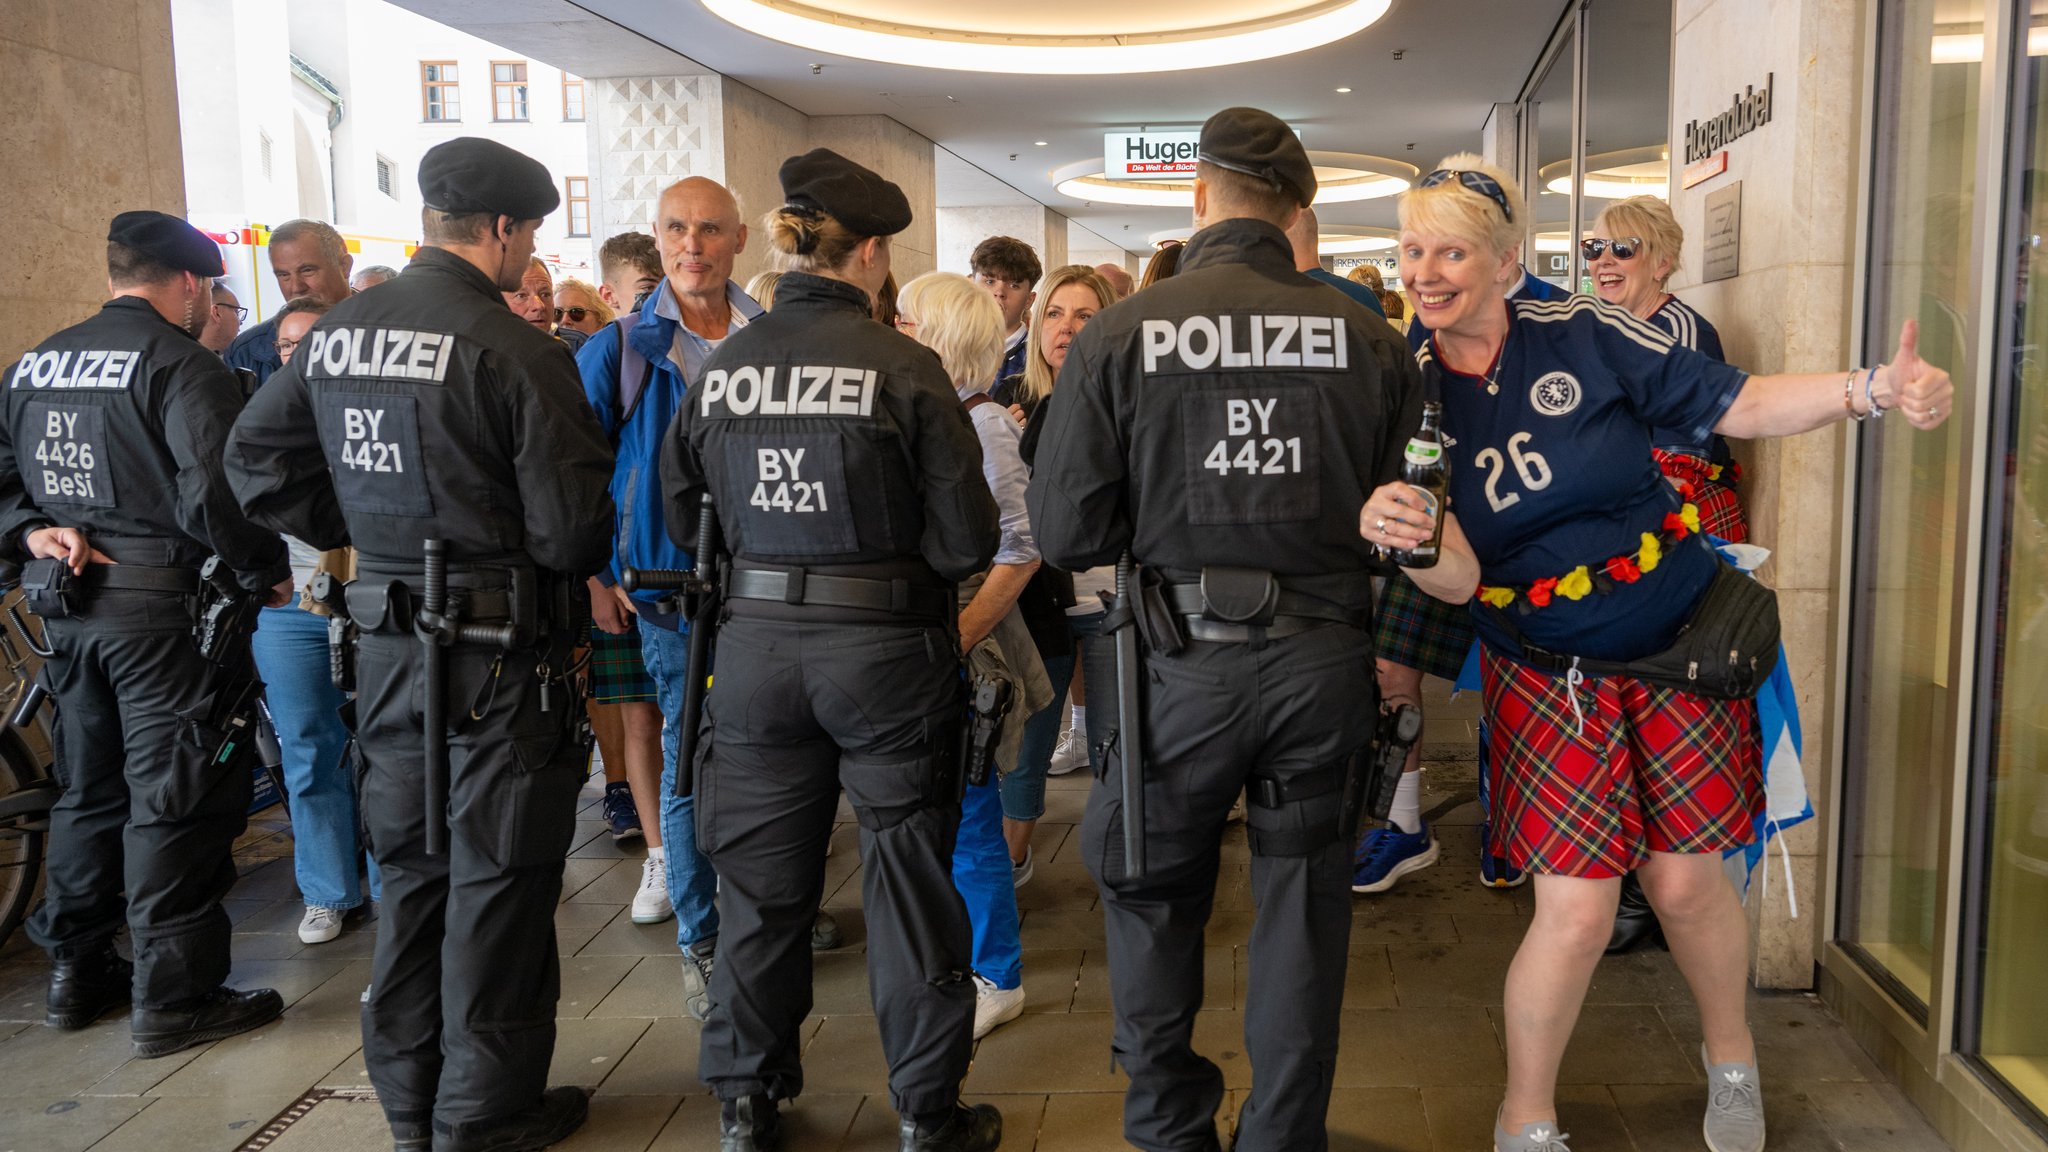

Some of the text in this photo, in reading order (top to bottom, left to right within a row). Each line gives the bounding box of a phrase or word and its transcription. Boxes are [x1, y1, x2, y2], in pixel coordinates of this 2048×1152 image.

[1684, 72, 1774, 165] Hugendubel
[308, 329, 453, 381] POLIZEI
[1143, 315, 1347, 373] POLIZEI
[11, 350, 140, 389] POLIZEI
[701, 366, 874, 417] POLIZEI
[46, 410, 78, 439] BY
[344, 408, 384, 440] BY
[1227, 399, 1277, 436] BY
[35, 440, 95, 470] 4426
[341, 440, 403, 472] 4421
[758, 448, 805, 481] BY
[1204, 437, 1300, 476] 4421
[1475, 431, 1552, 513] 26
[42, 470, 95, 498] BeSi
[750, 481, 827, 512] 4421
